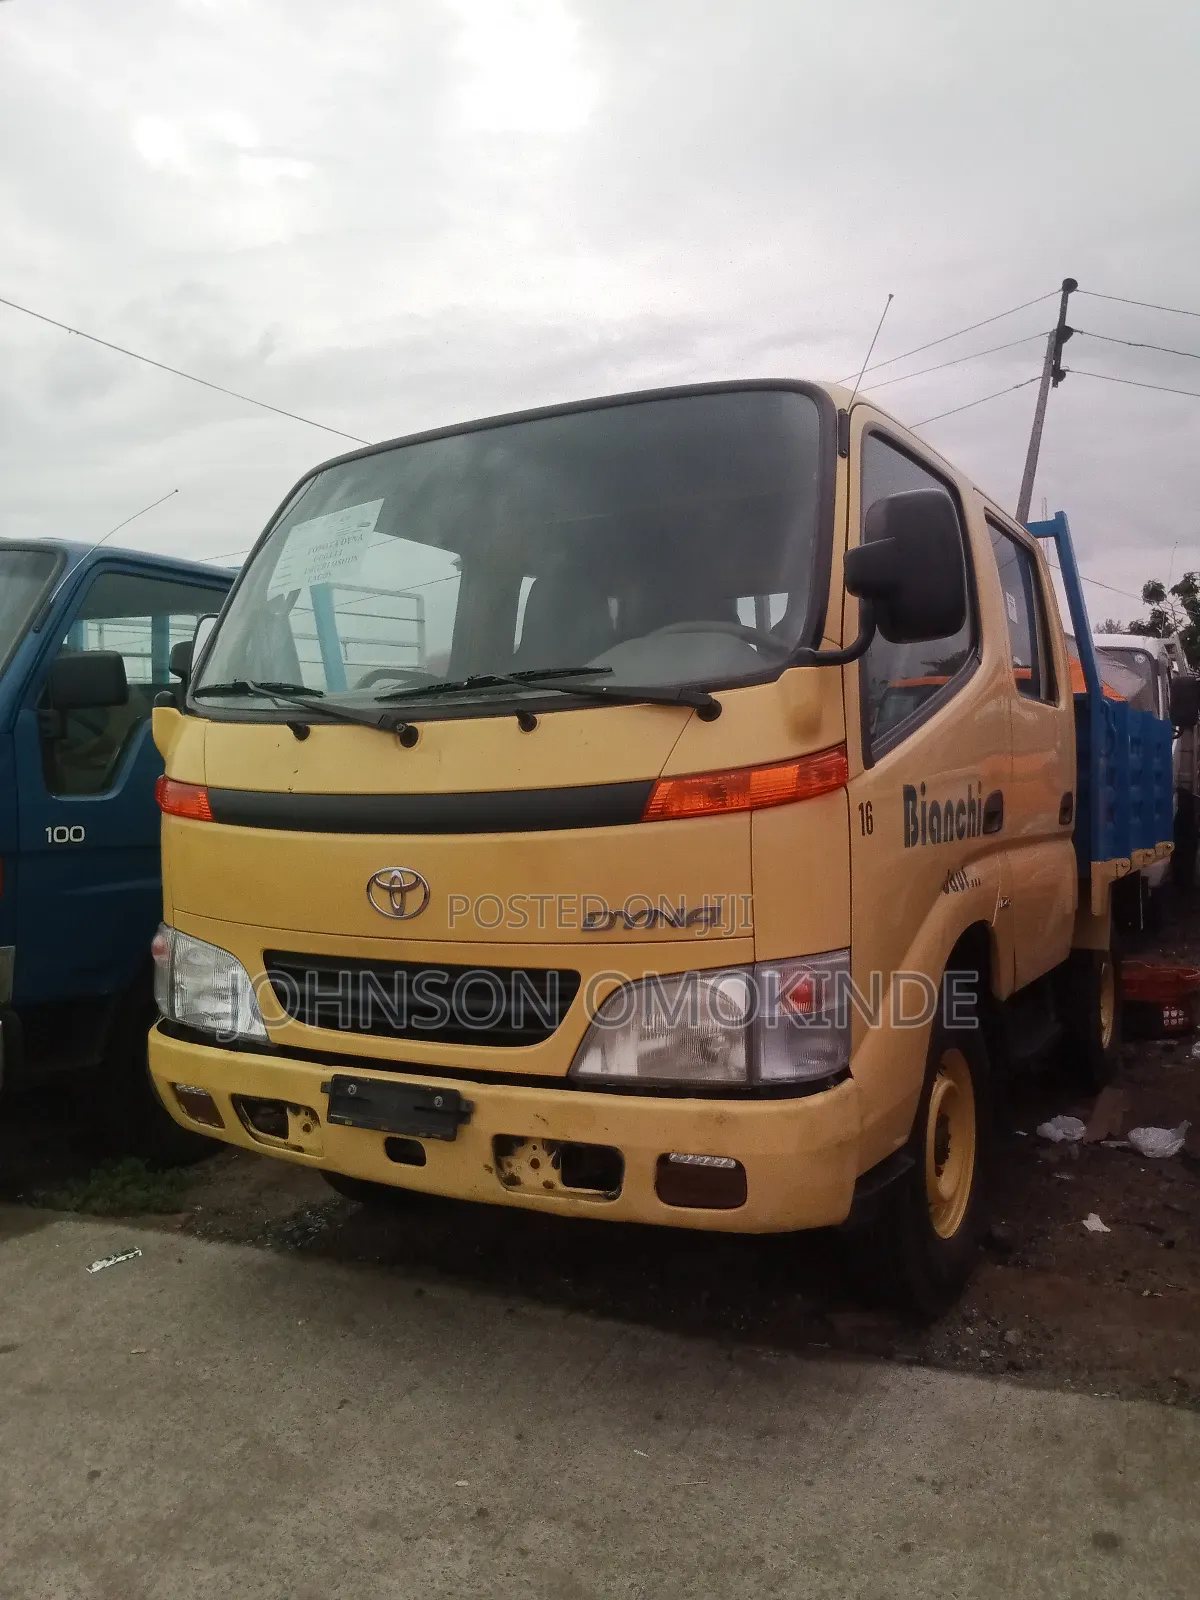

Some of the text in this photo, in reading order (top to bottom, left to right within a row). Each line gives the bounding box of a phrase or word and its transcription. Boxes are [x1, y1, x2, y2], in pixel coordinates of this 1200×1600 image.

[858, 800, 874, 836] 16
[902, 781, 984, 848] Bianchi
[45, 825, 85, 843] 100
[581, 904, 722, 932] DYNA
